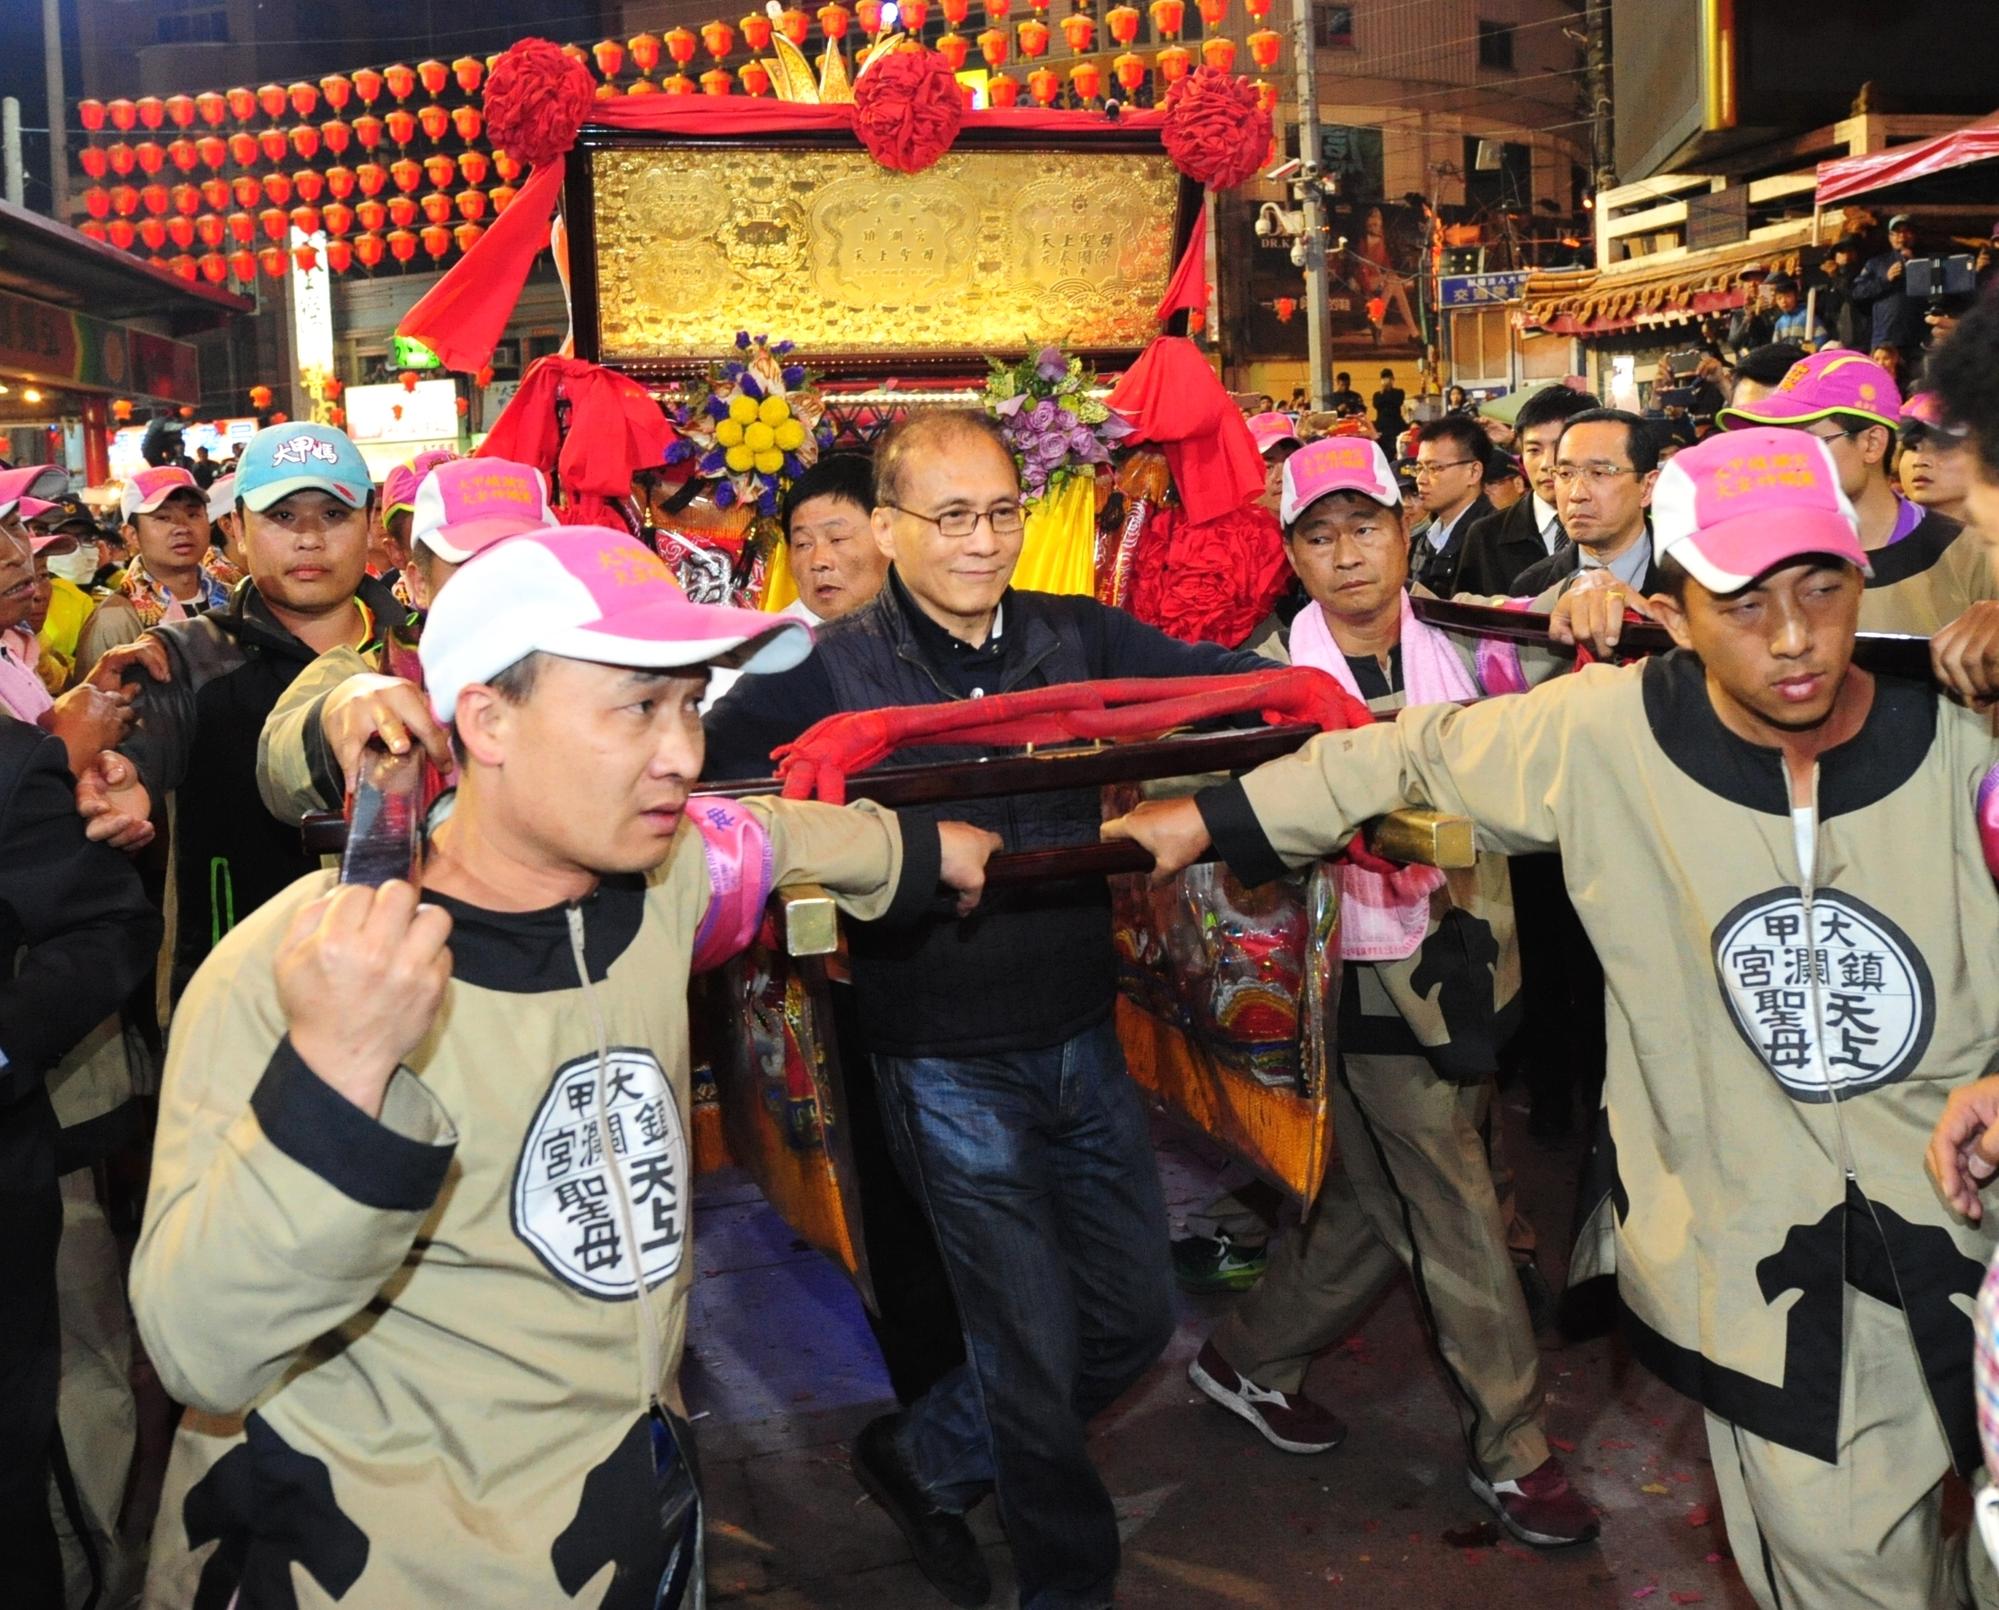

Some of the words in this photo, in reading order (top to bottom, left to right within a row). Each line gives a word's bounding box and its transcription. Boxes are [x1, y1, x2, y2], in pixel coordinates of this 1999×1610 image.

[1041, 232, 1114, 248] 天上聖母
[271, 435, 338, 468] 大甲媽
